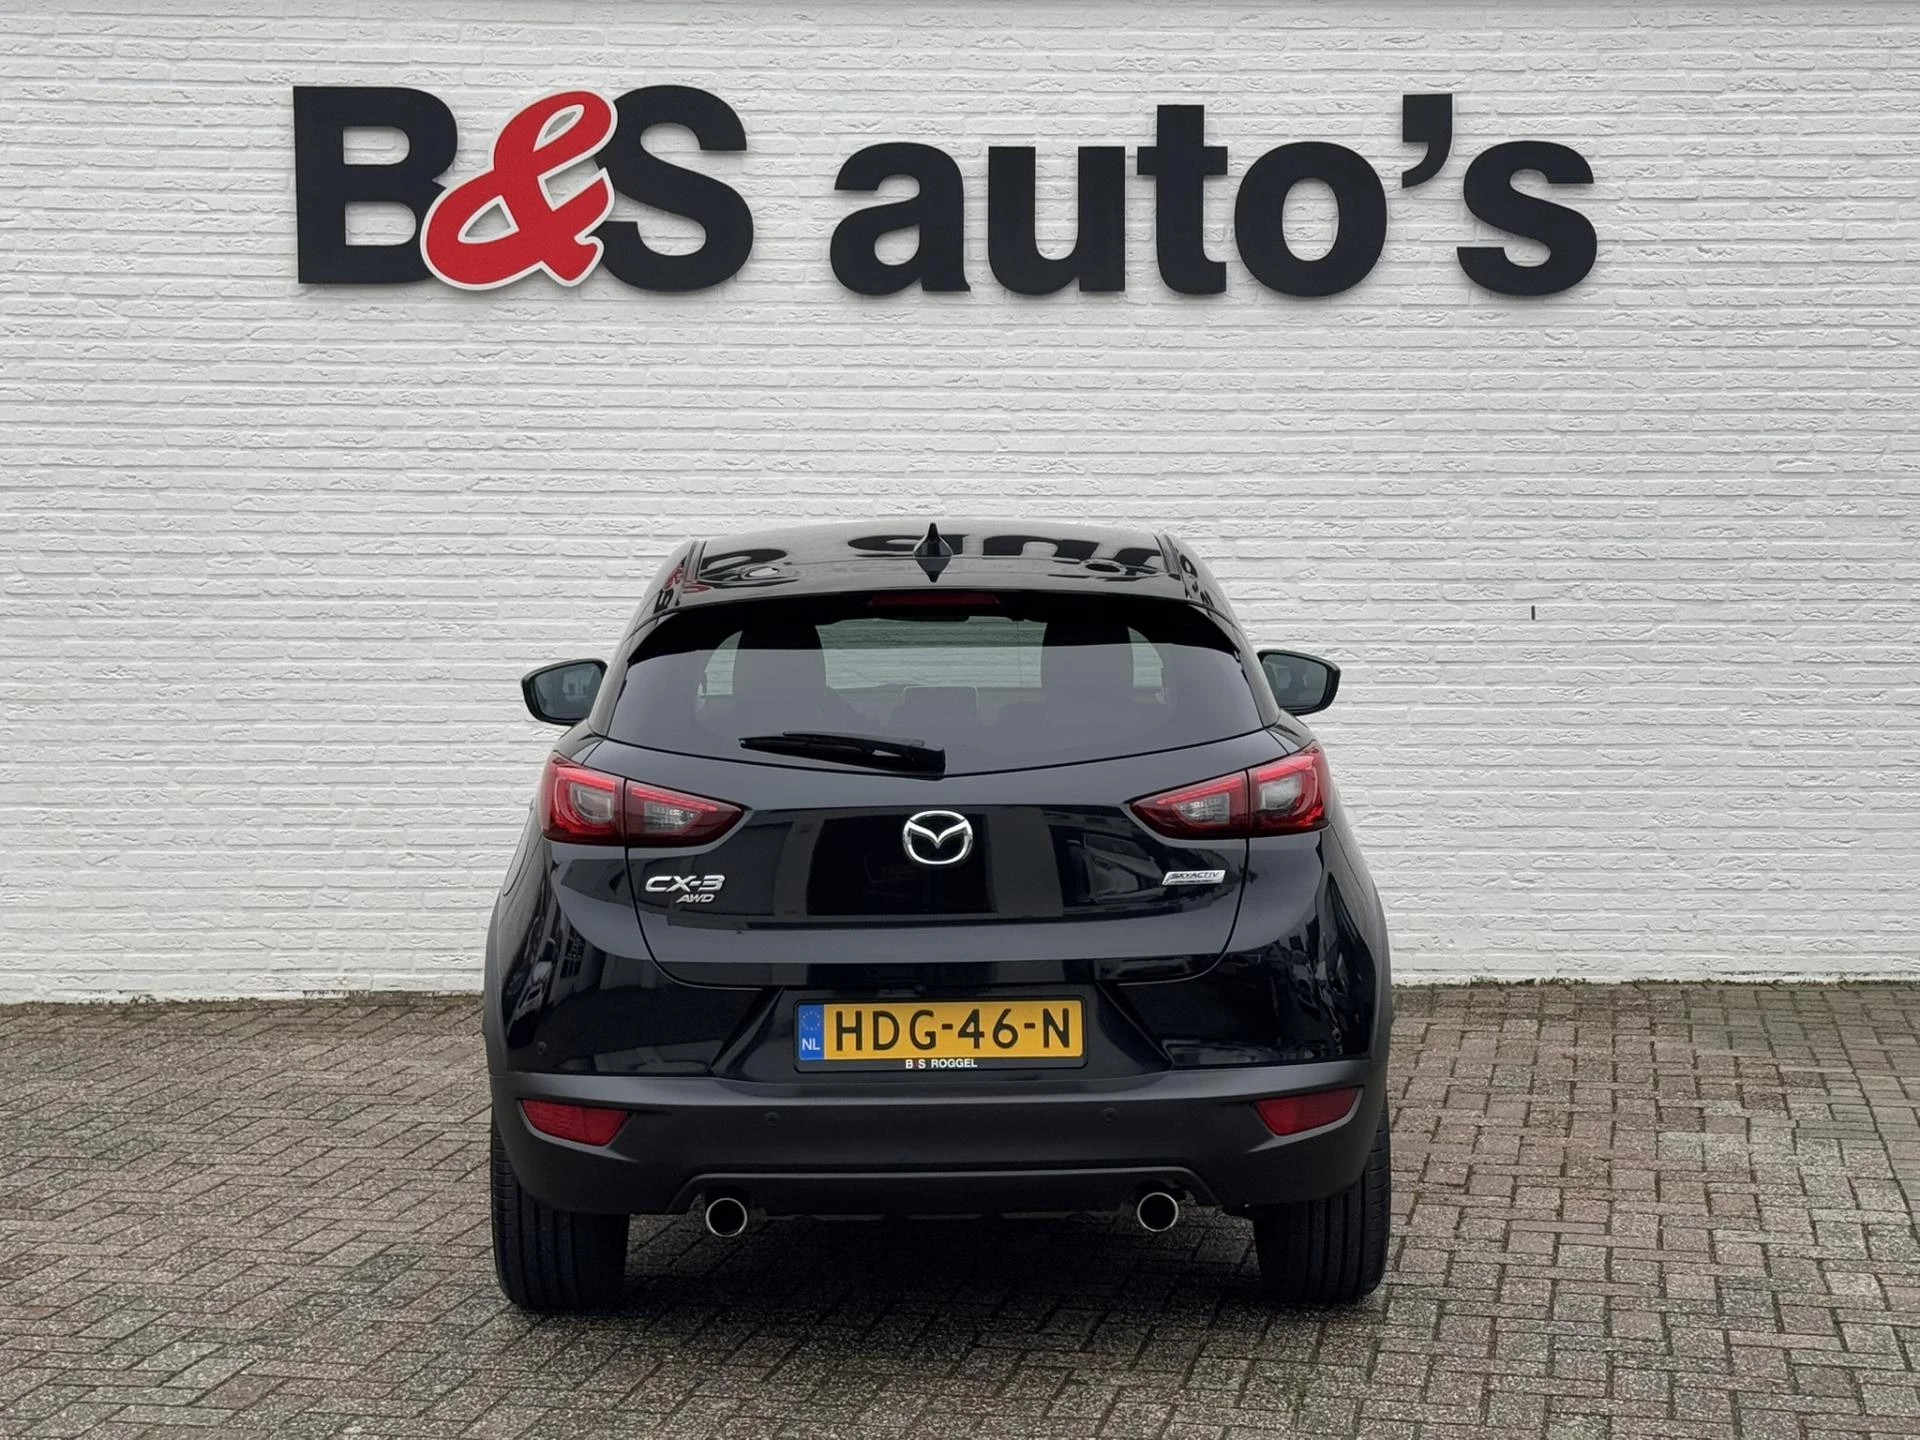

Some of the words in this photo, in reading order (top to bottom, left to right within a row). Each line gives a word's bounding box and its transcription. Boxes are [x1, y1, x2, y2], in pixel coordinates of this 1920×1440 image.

[293, 84, 755, 291] B&S
[829, 93, 1599, 298] auto's
[1169, 870, 1220, 880] SKYACTIV
[645, 874, 726, 892] CX-3
[675, 893, 715, 903] AWD
[835, 1007, 1070, 1052] HDG-46-N
[801, 1037, 821, 1051] NL
[930, 1057, 978, 1069] ROGGEL
